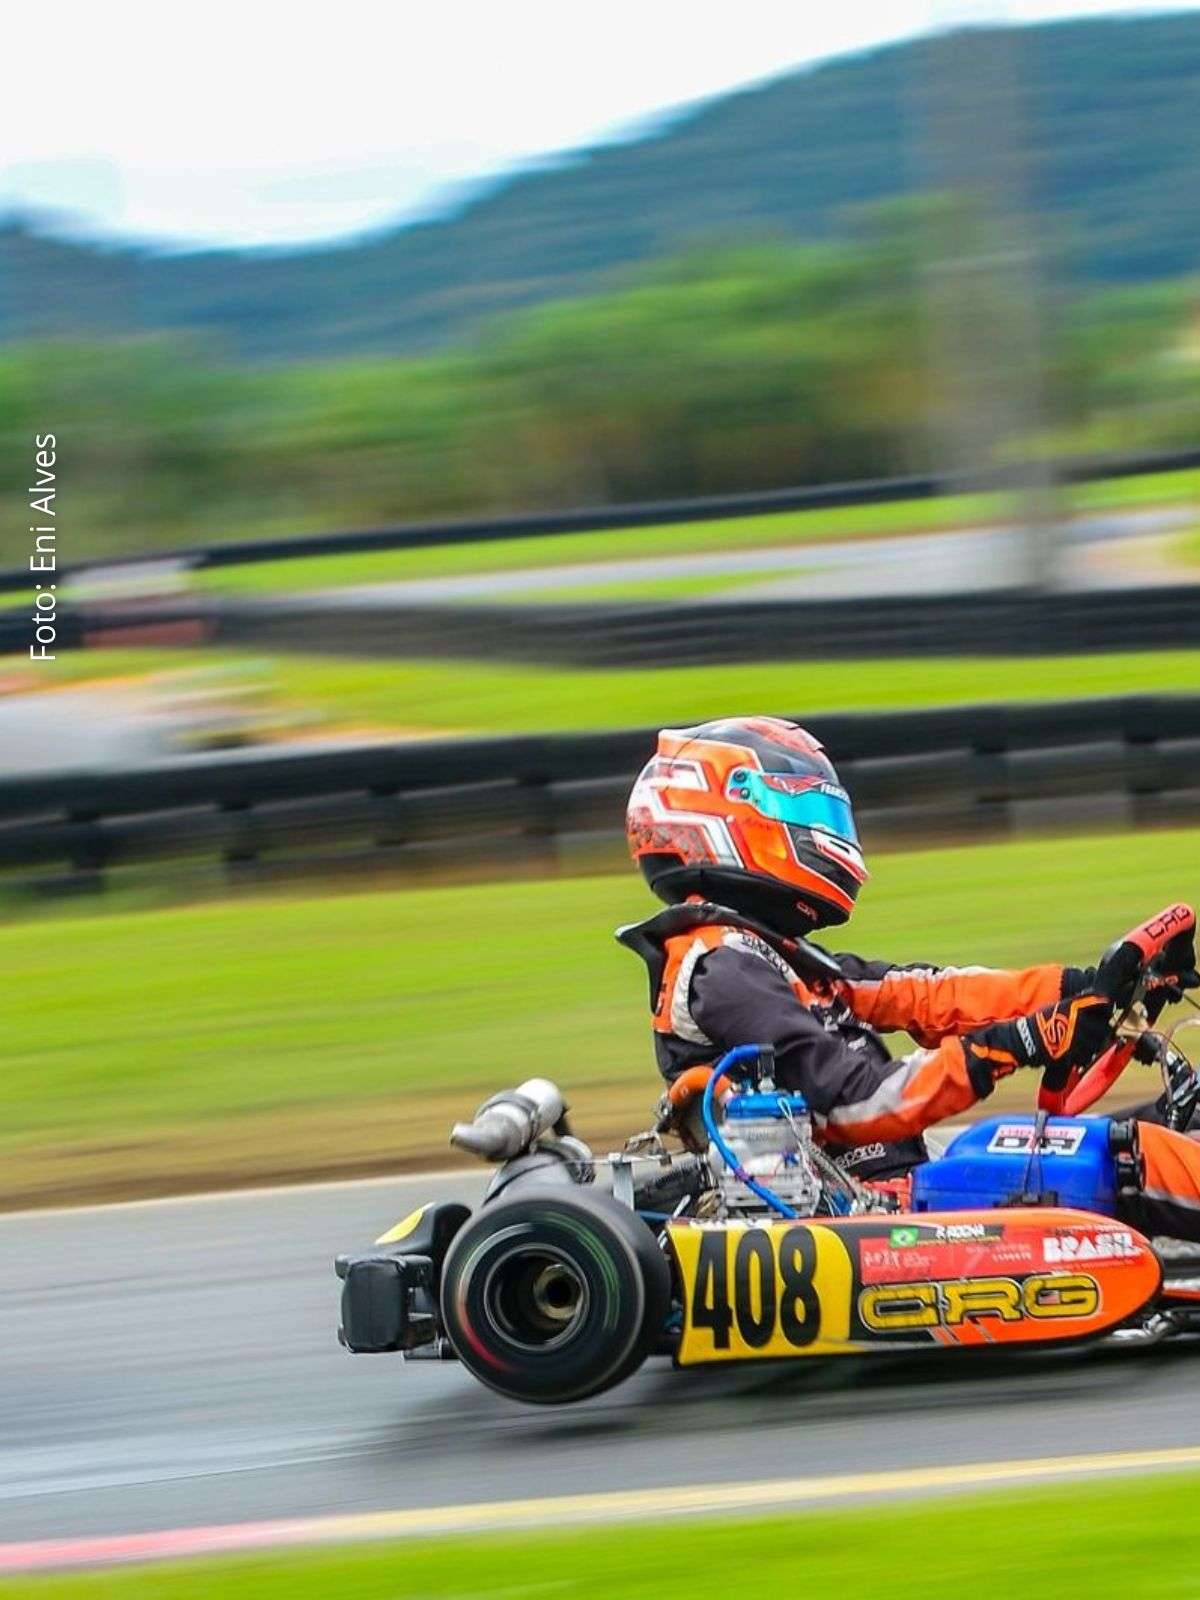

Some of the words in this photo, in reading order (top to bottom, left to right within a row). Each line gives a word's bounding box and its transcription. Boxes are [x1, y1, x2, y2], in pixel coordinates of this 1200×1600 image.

[1042, 1232, 1143, 1263] BRASIL
[692, 1225, 822, 1350] 408
[858, 1273, 1103, 1333] CRG
